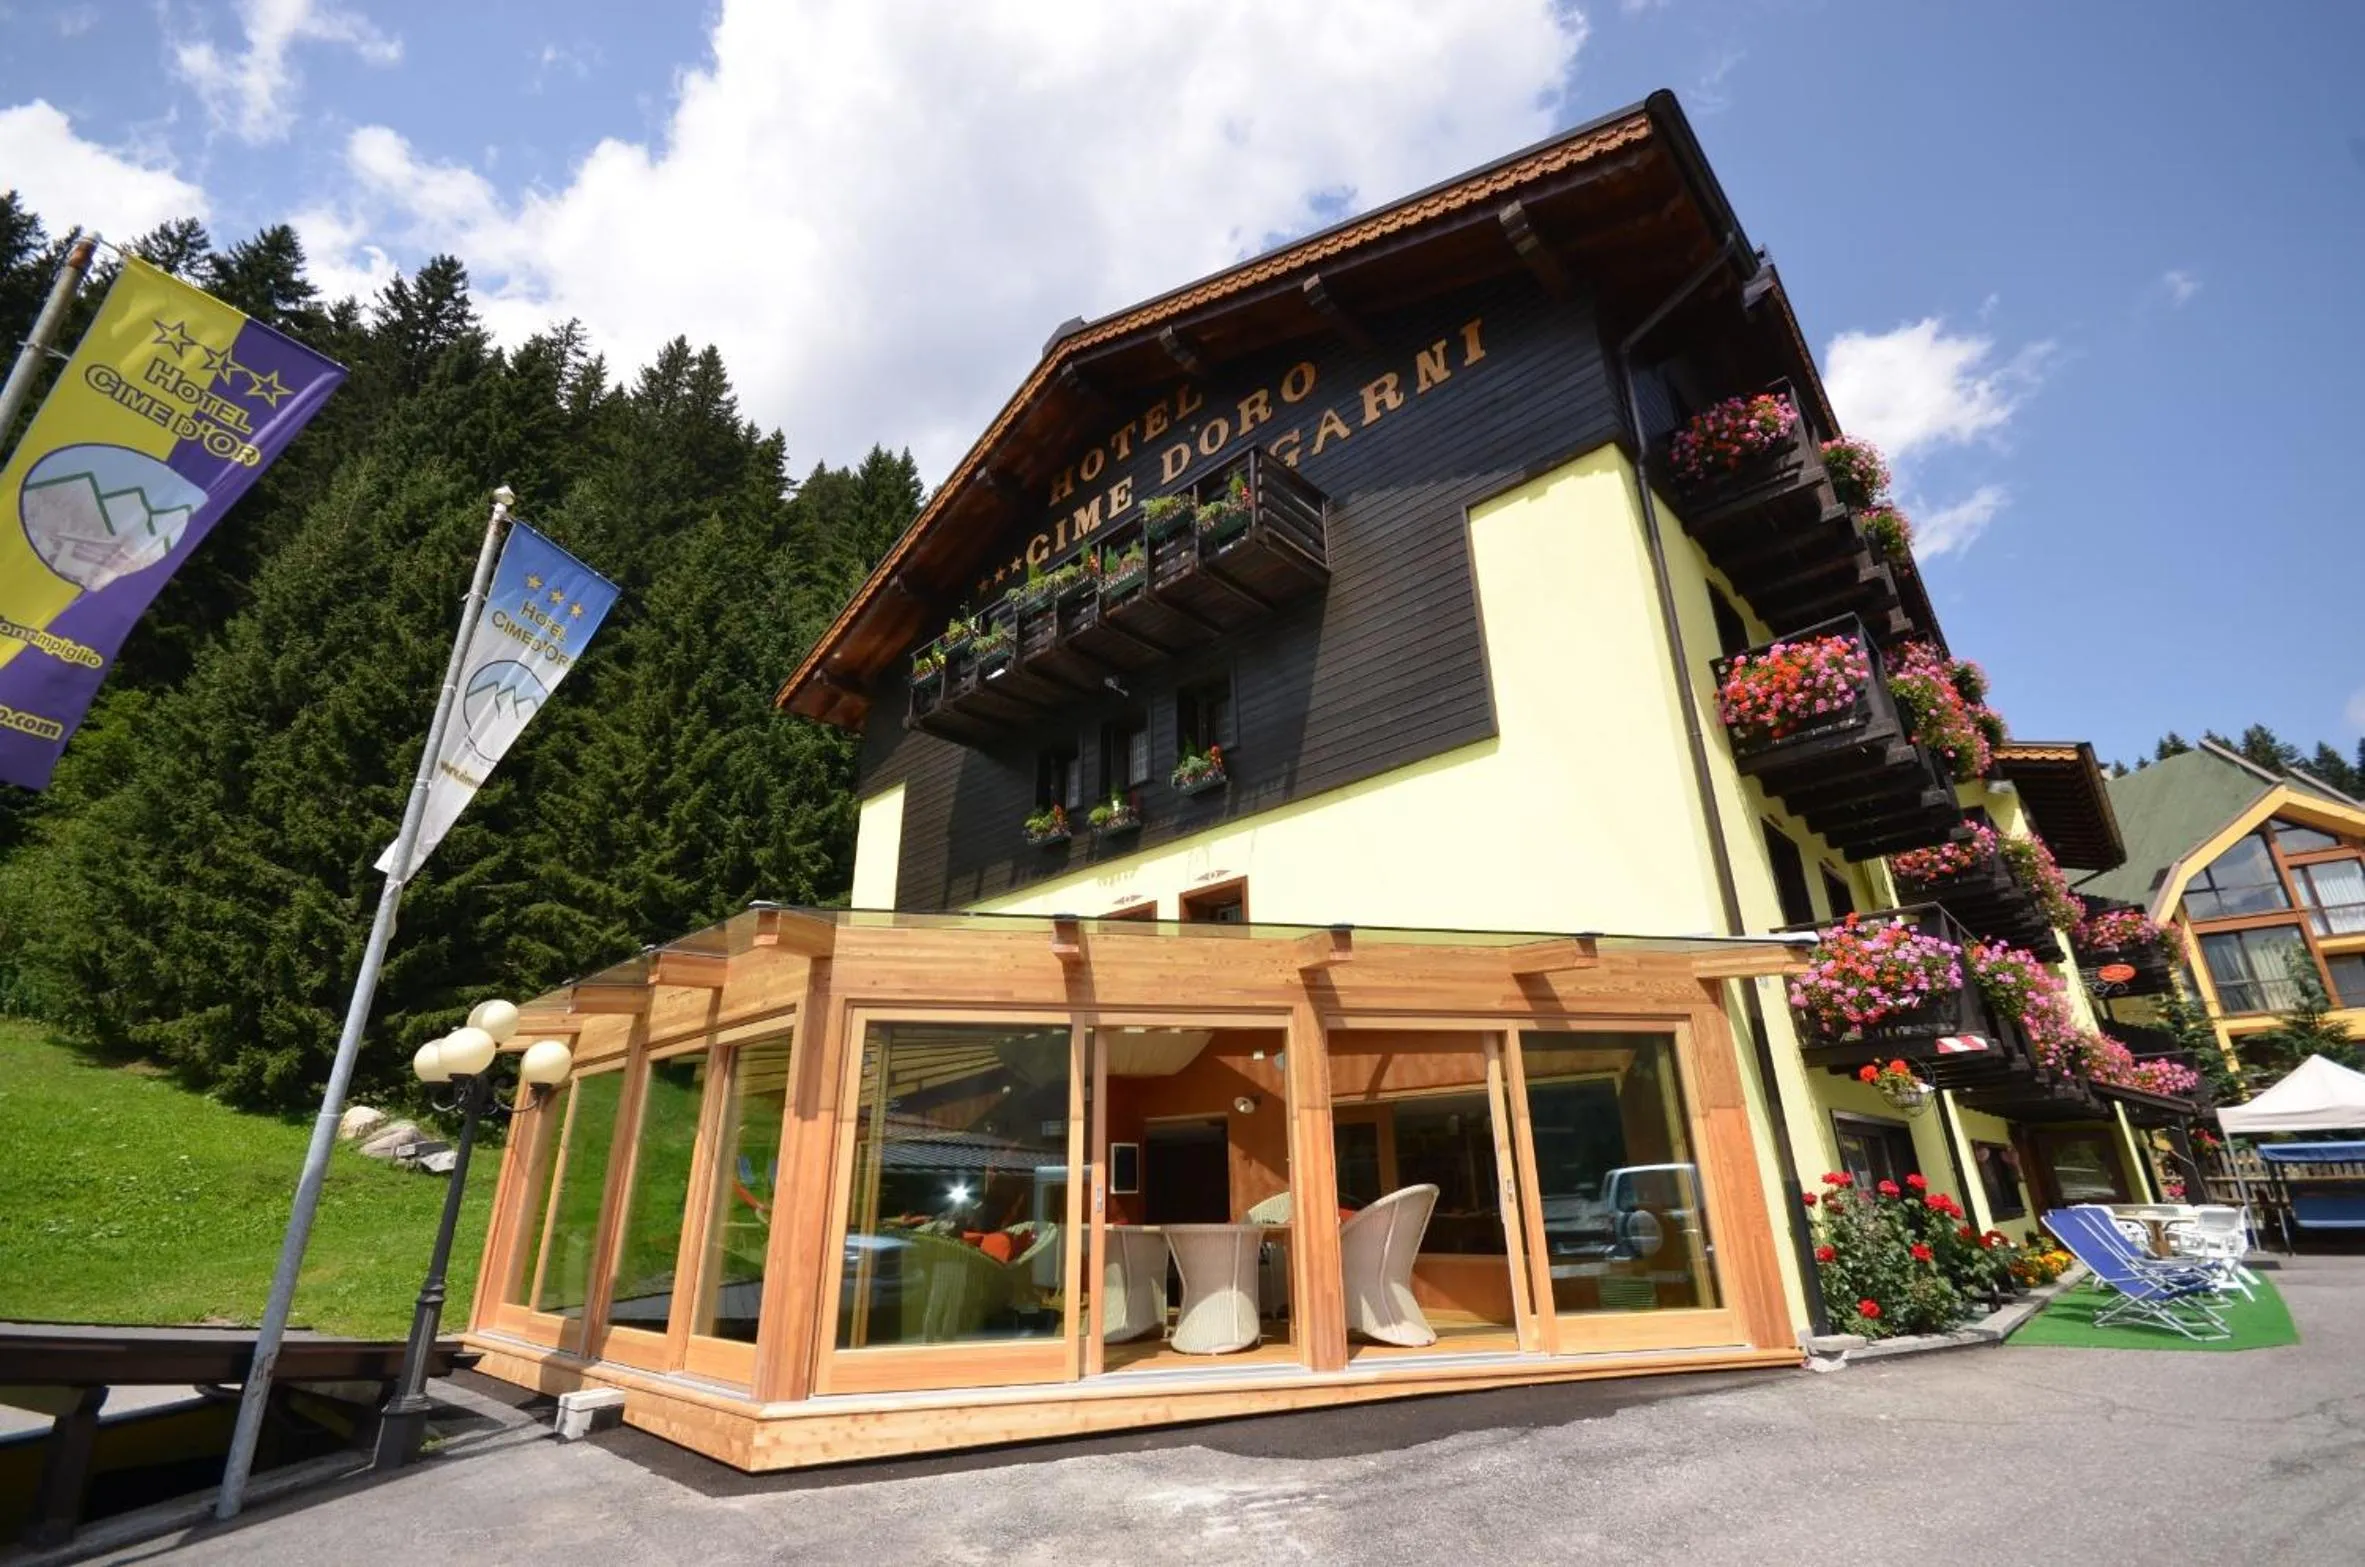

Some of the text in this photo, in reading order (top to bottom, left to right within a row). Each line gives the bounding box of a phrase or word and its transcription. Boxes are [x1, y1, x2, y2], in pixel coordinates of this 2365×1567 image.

[84, 363, 262, 467] CIME D'OR
[143, 356, 254, 436] HOTEL
[1048, 382, 1204, 507] HOTEL
[1268, 317, 1488, 468] GARNI
[1025, 360, 1320, 565] CIME D'ORO
